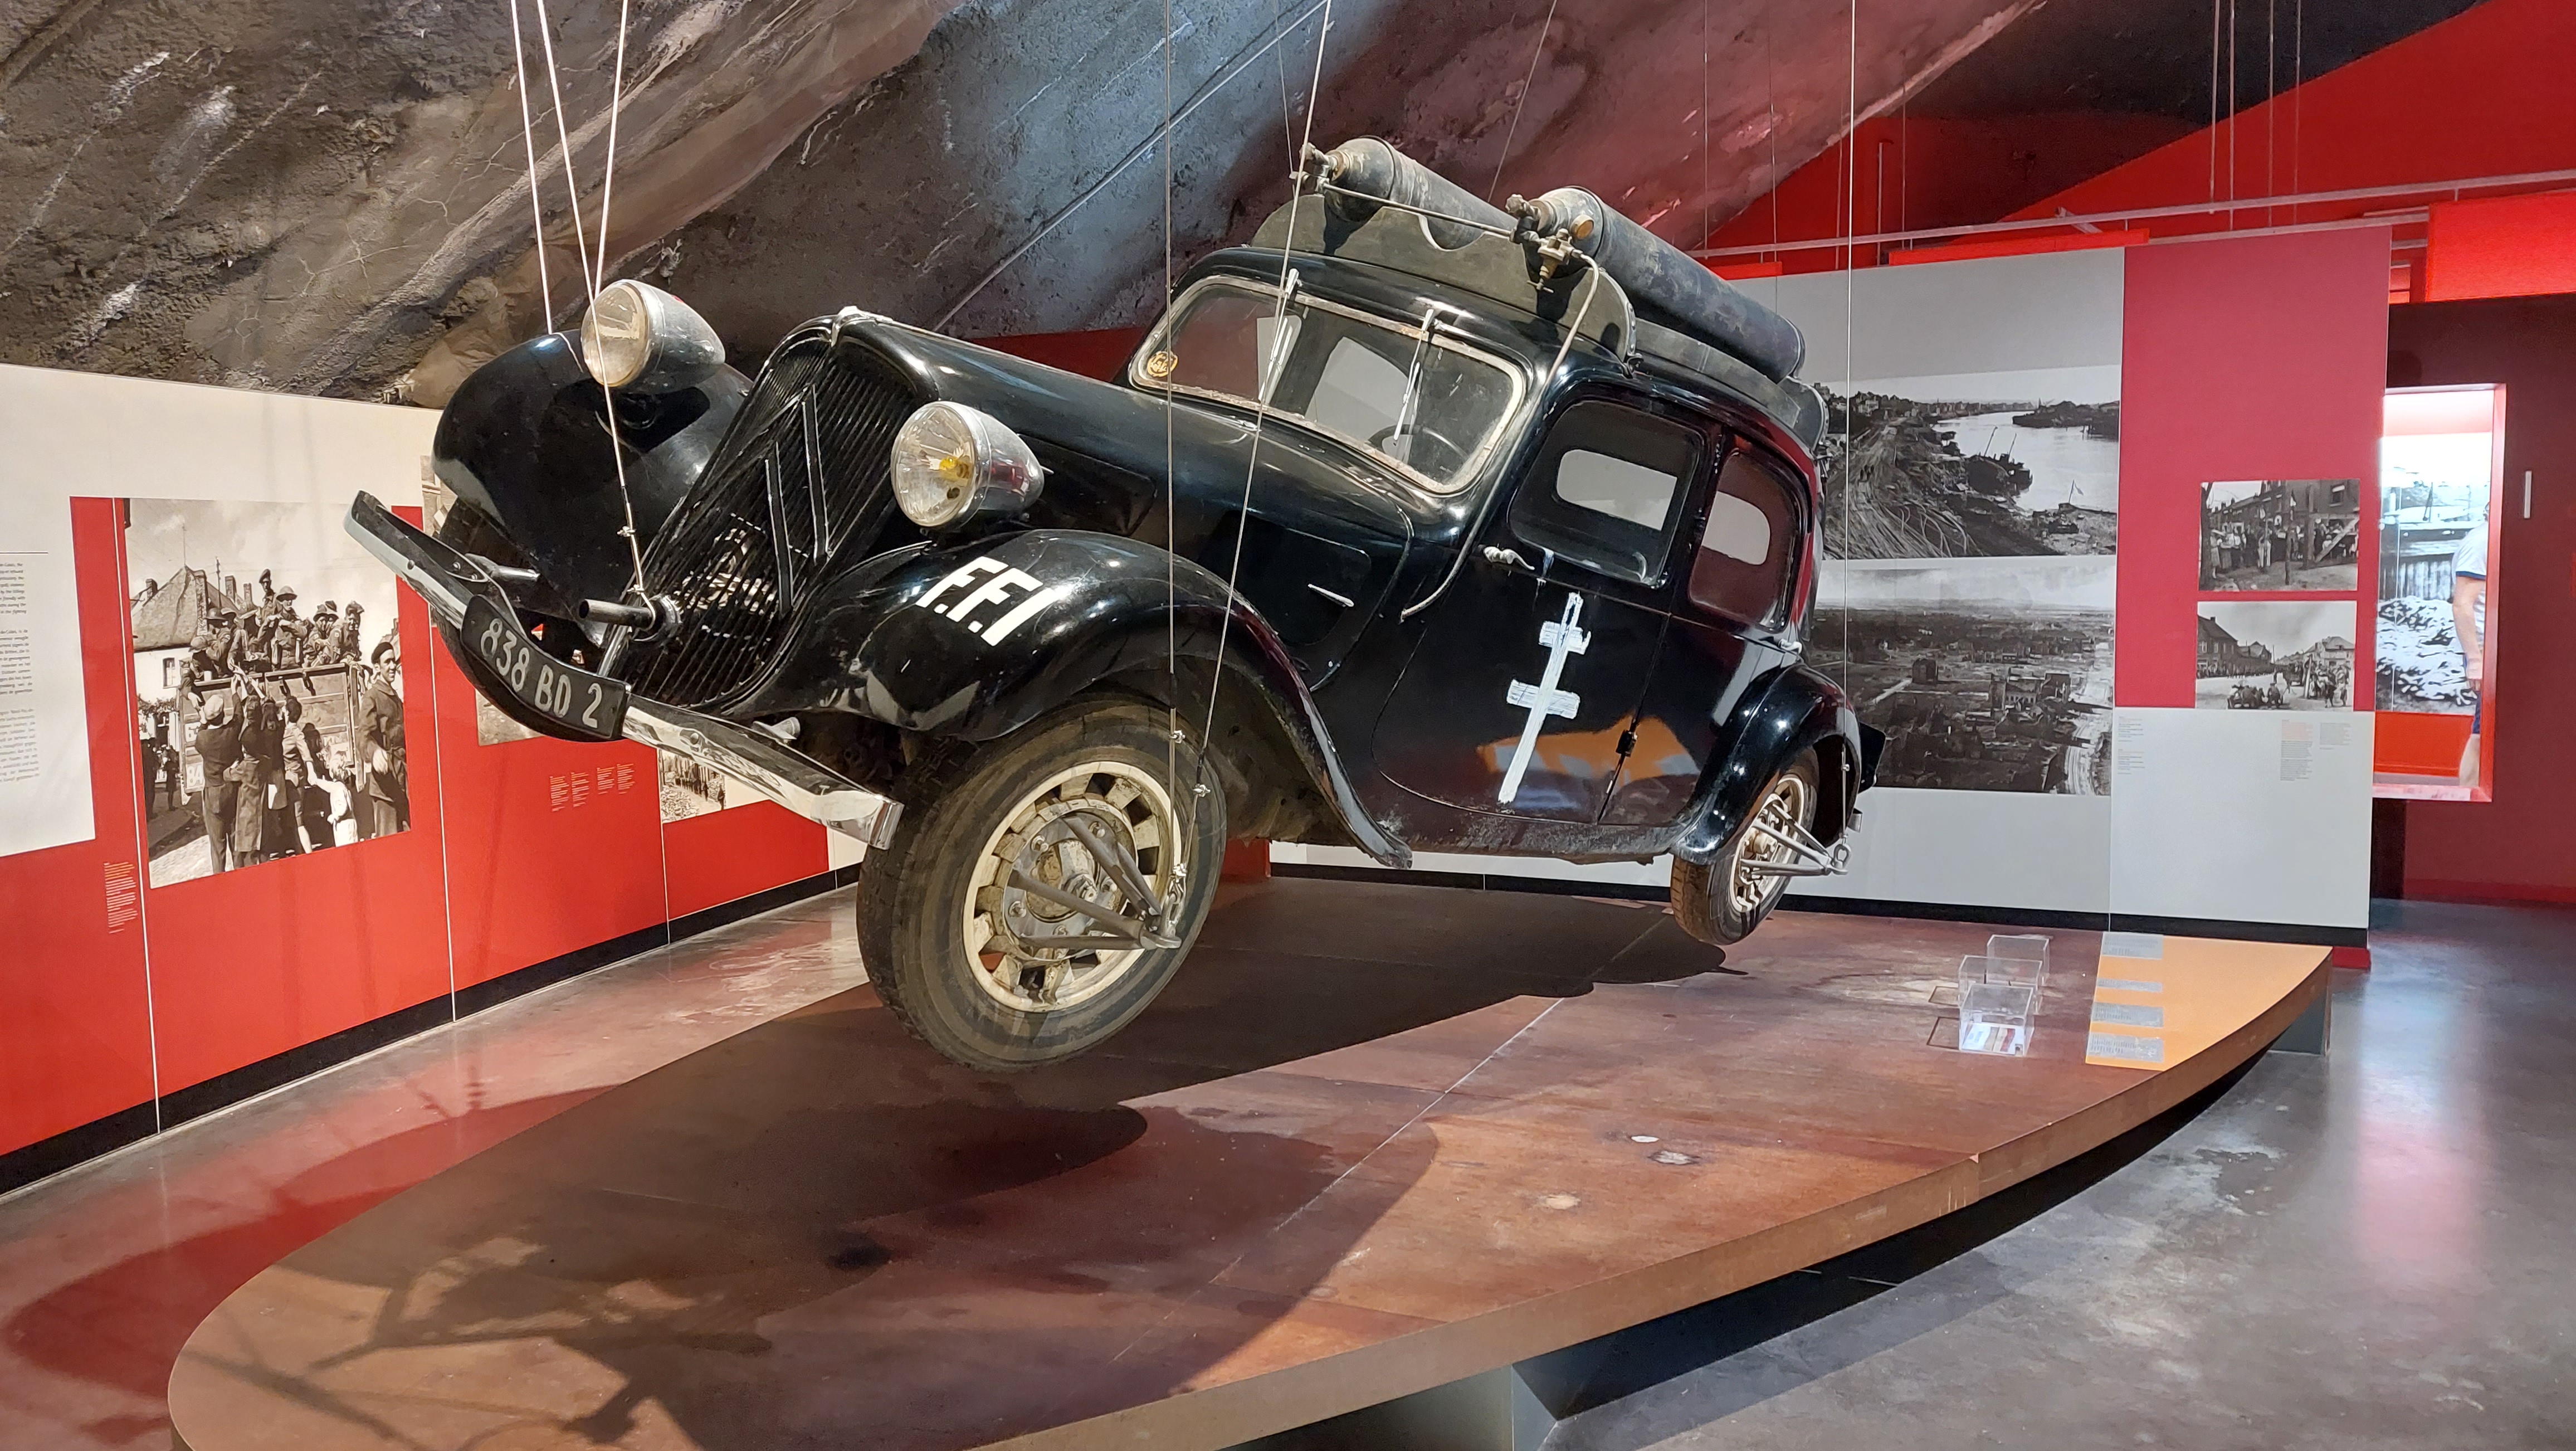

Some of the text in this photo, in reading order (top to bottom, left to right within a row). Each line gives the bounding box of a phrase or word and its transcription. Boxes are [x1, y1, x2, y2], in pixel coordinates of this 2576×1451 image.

[480, 618, 603, 729] 838 BD 2
